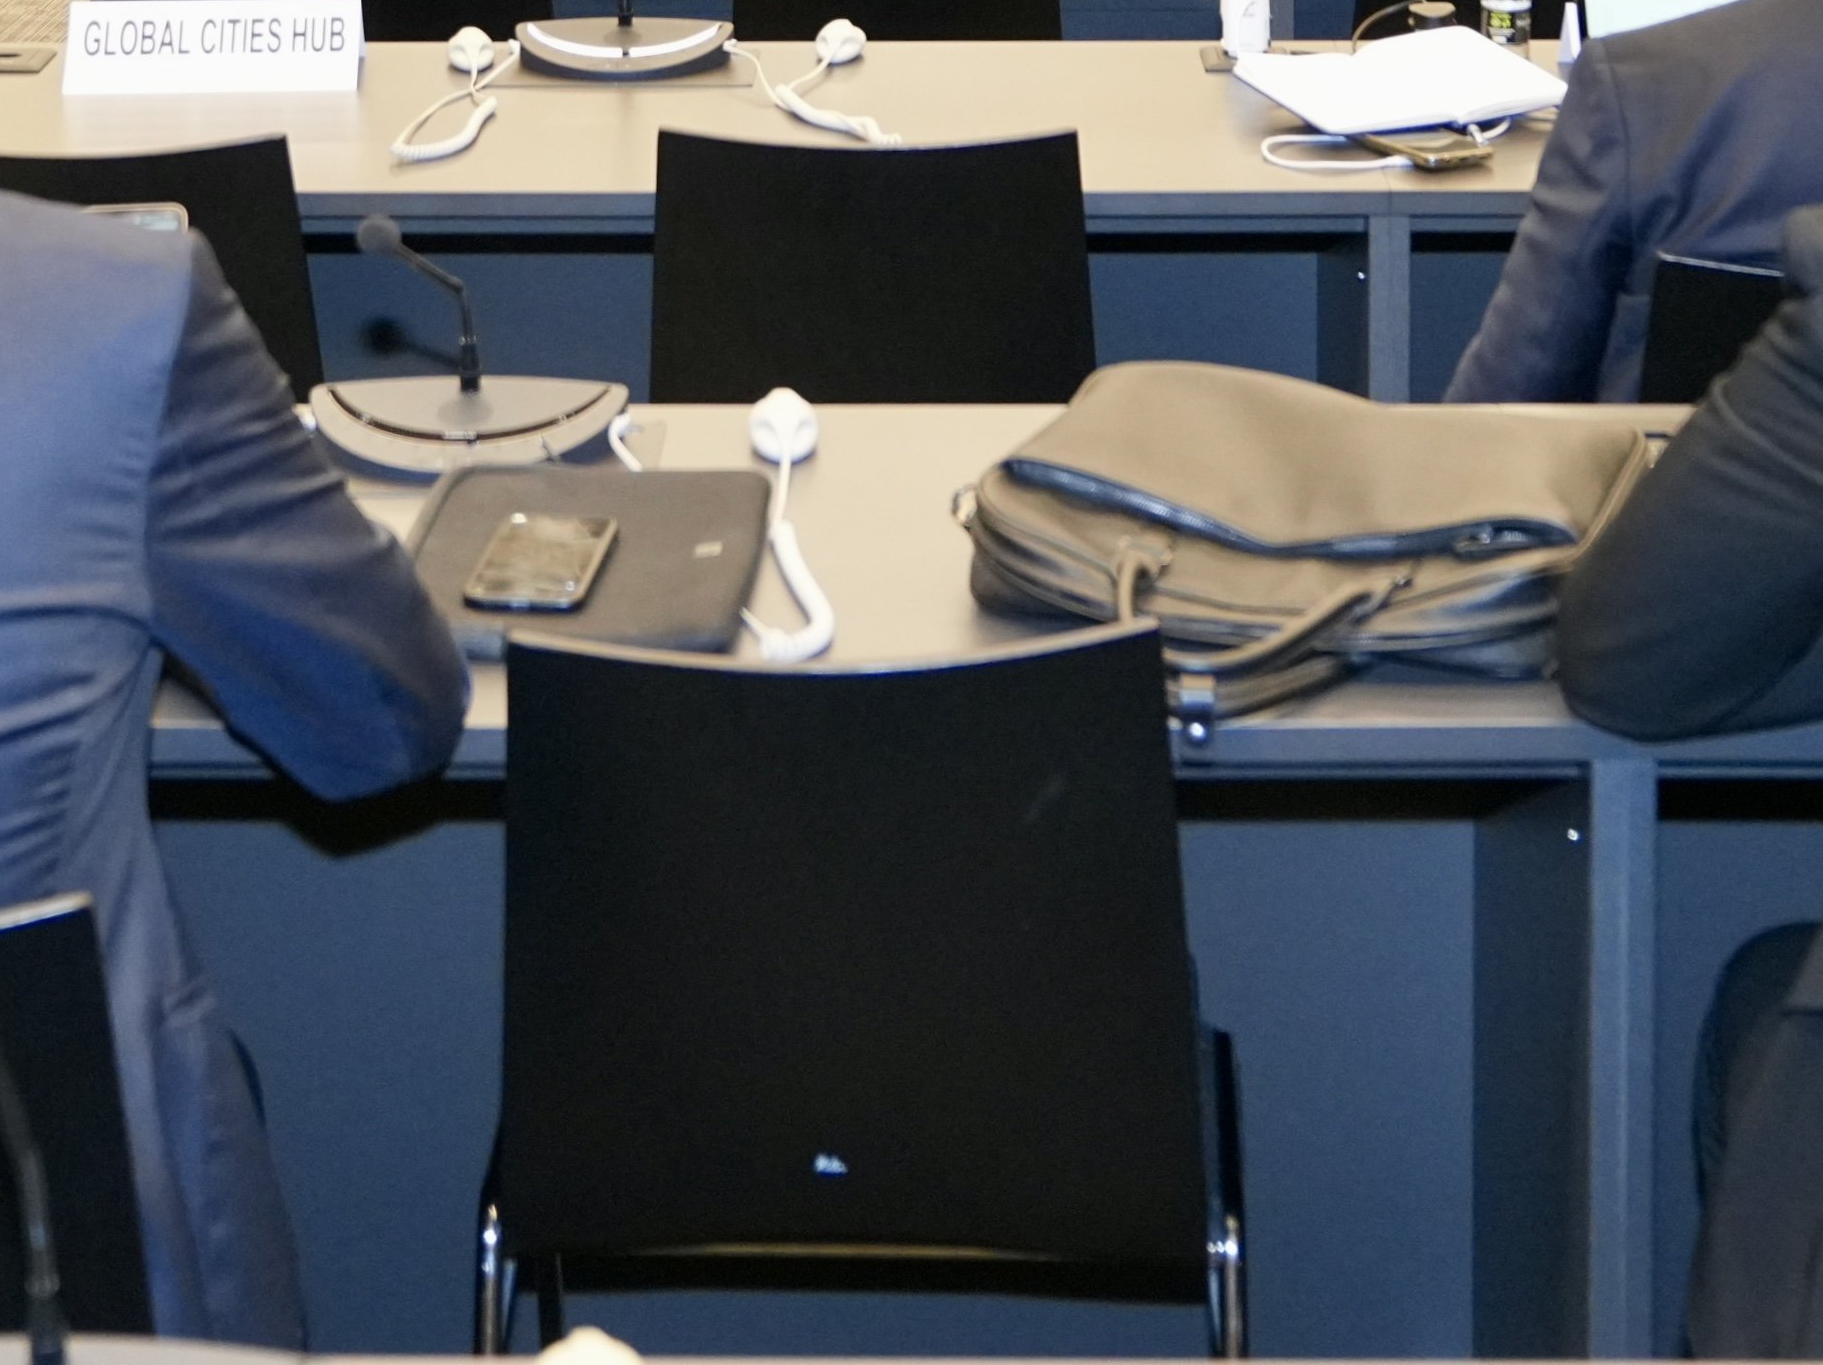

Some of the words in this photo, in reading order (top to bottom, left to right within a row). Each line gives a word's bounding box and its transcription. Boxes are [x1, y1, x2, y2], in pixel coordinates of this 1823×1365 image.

[83, 20, 190, 56] GLOBAL
[200, 19, 282, 55] CITIES
[292, 17, 346, 53] HUB
